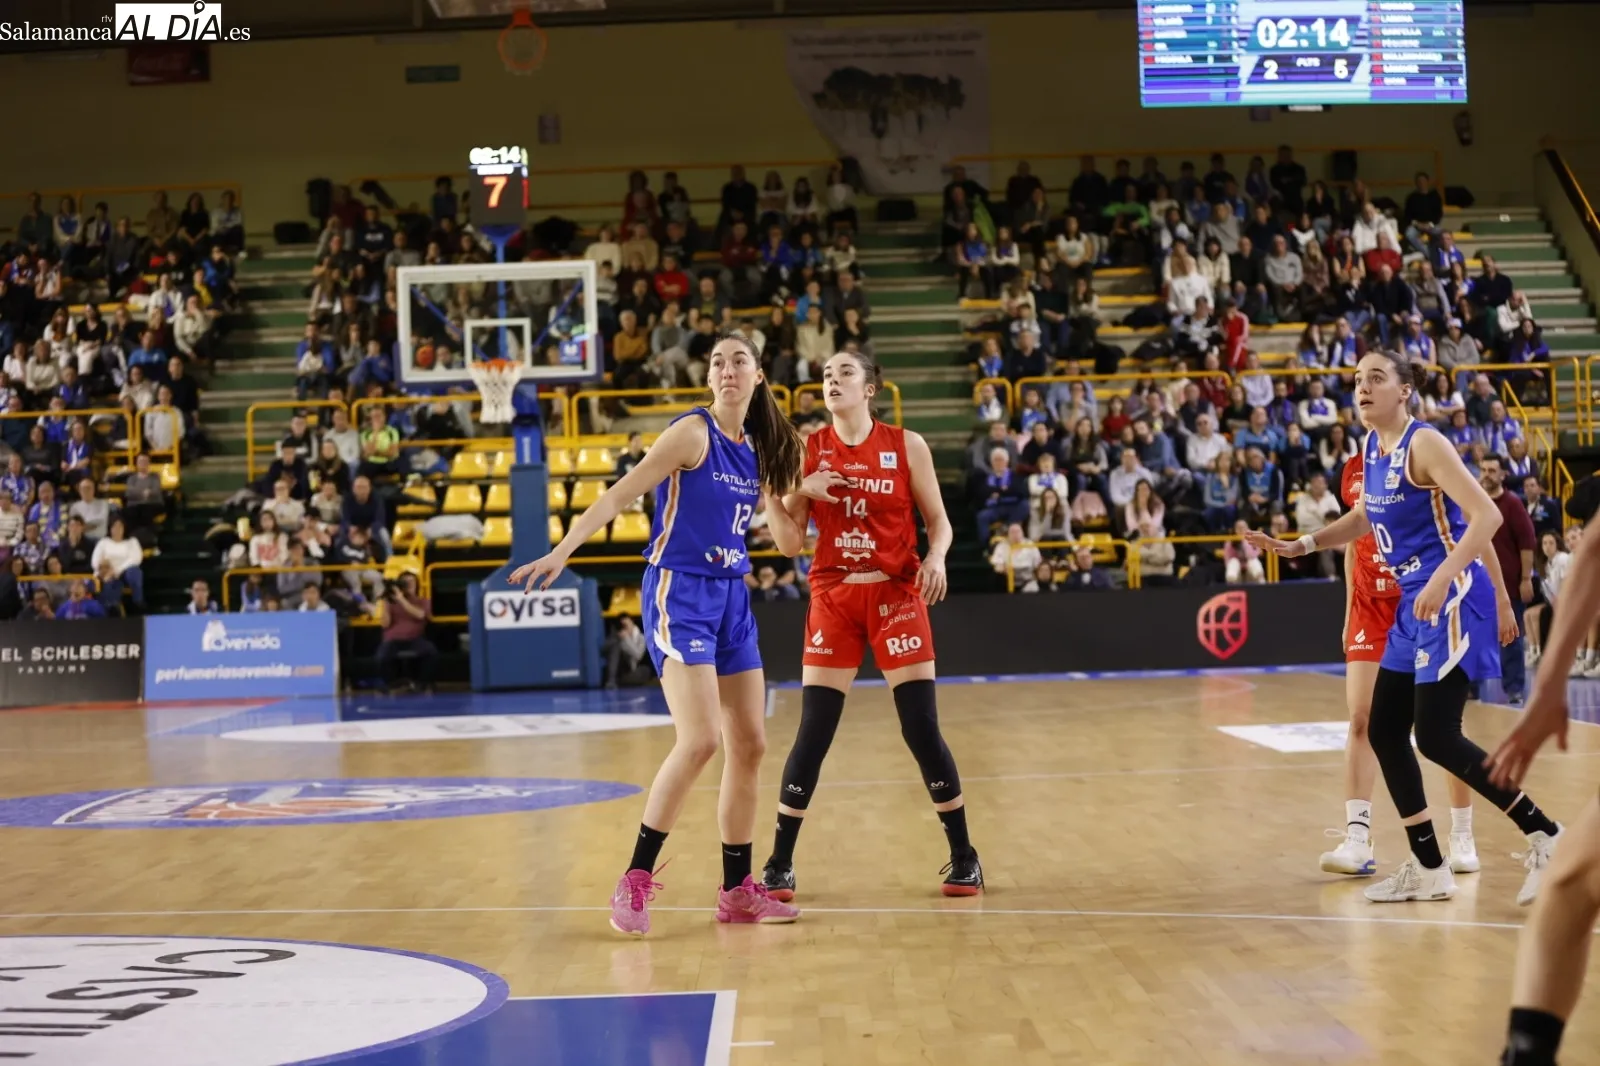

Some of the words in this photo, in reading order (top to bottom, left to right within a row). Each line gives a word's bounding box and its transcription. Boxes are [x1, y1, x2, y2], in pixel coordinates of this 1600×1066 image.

[1257, 18, 1350, 48] 02:14
[1263, 59, 1279, 80] 2
[1334, 58, 1349, 79] 5
[483, 176, 508, 208] 7
[847, 476, 894, 494] SINO
[732, 503, 752, 535] 12
[843, 496, 868, 519] 14
[488, 596, 578, 623] oyrsa
[31, 643, 141, 662] SCHLESSER
[886, 633, 922, 656] Río
